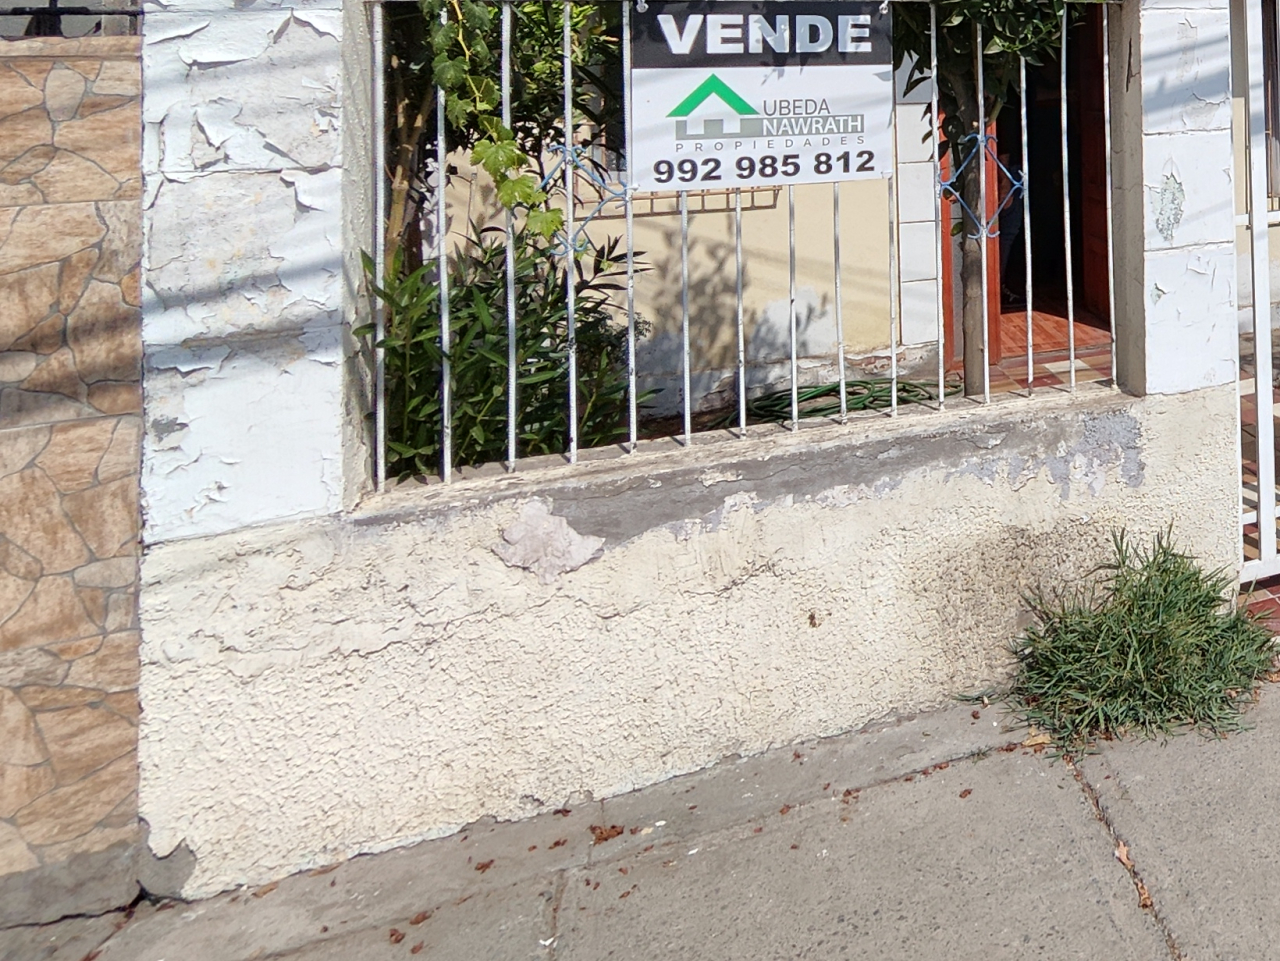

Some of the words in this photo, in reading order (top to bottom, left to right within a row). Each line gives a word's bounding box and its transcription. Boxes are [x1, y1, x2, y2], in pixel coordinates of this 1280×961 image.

[657, 14, 872, 54] VENDE
[763, 98, 831, 116] UBEDA
[762, 116, 862, 136] NAWRATH
[675, 135, 865, 153] PROPIEDADES
[653, 158, 721, 183] 992
[735, 154, 800, 179] 985
[813, 150, 875, 174] 812
